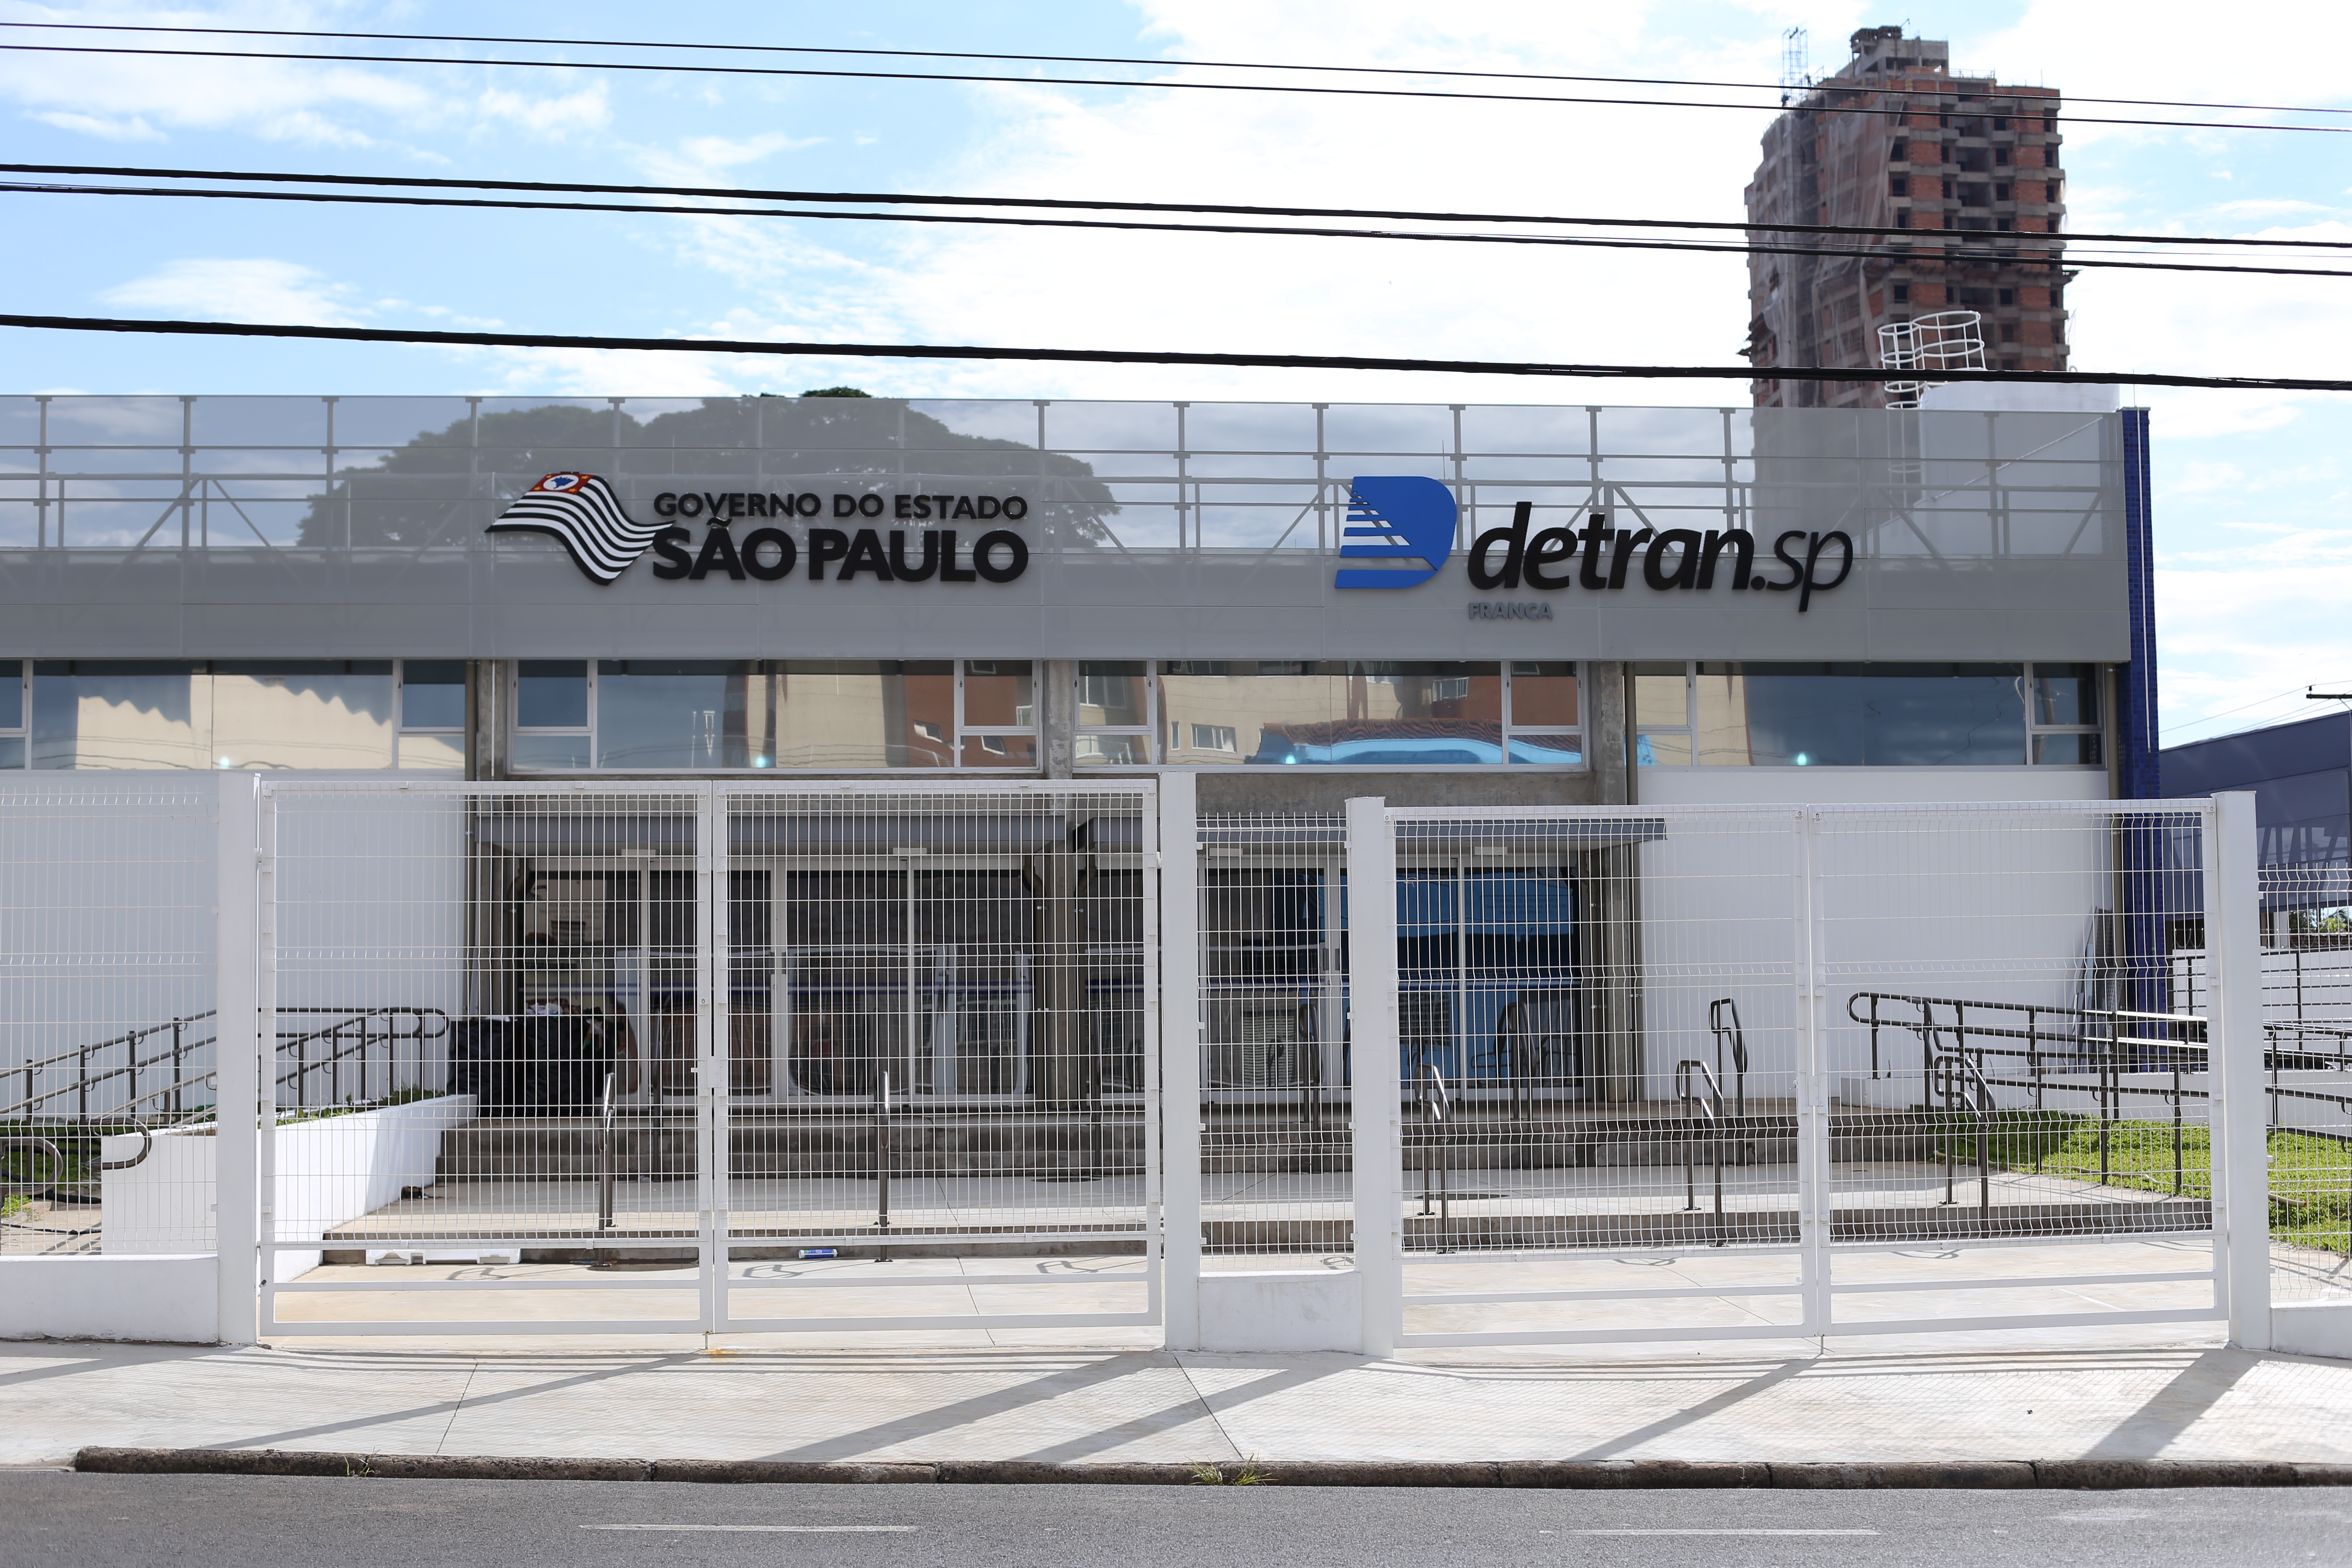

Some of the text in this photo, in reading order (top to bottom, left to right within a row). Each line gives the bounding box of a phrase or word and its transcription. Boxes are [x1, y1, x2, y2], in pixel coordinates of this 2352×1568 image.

[654, 493, 1028, 521] GOVERNO DO ESTADO
[652, 516, 1029, 583] SÃO PAULO
[1467, 501, 1853, 613] detran.sp
[1468, 603, 1553, 619] FRANCA
